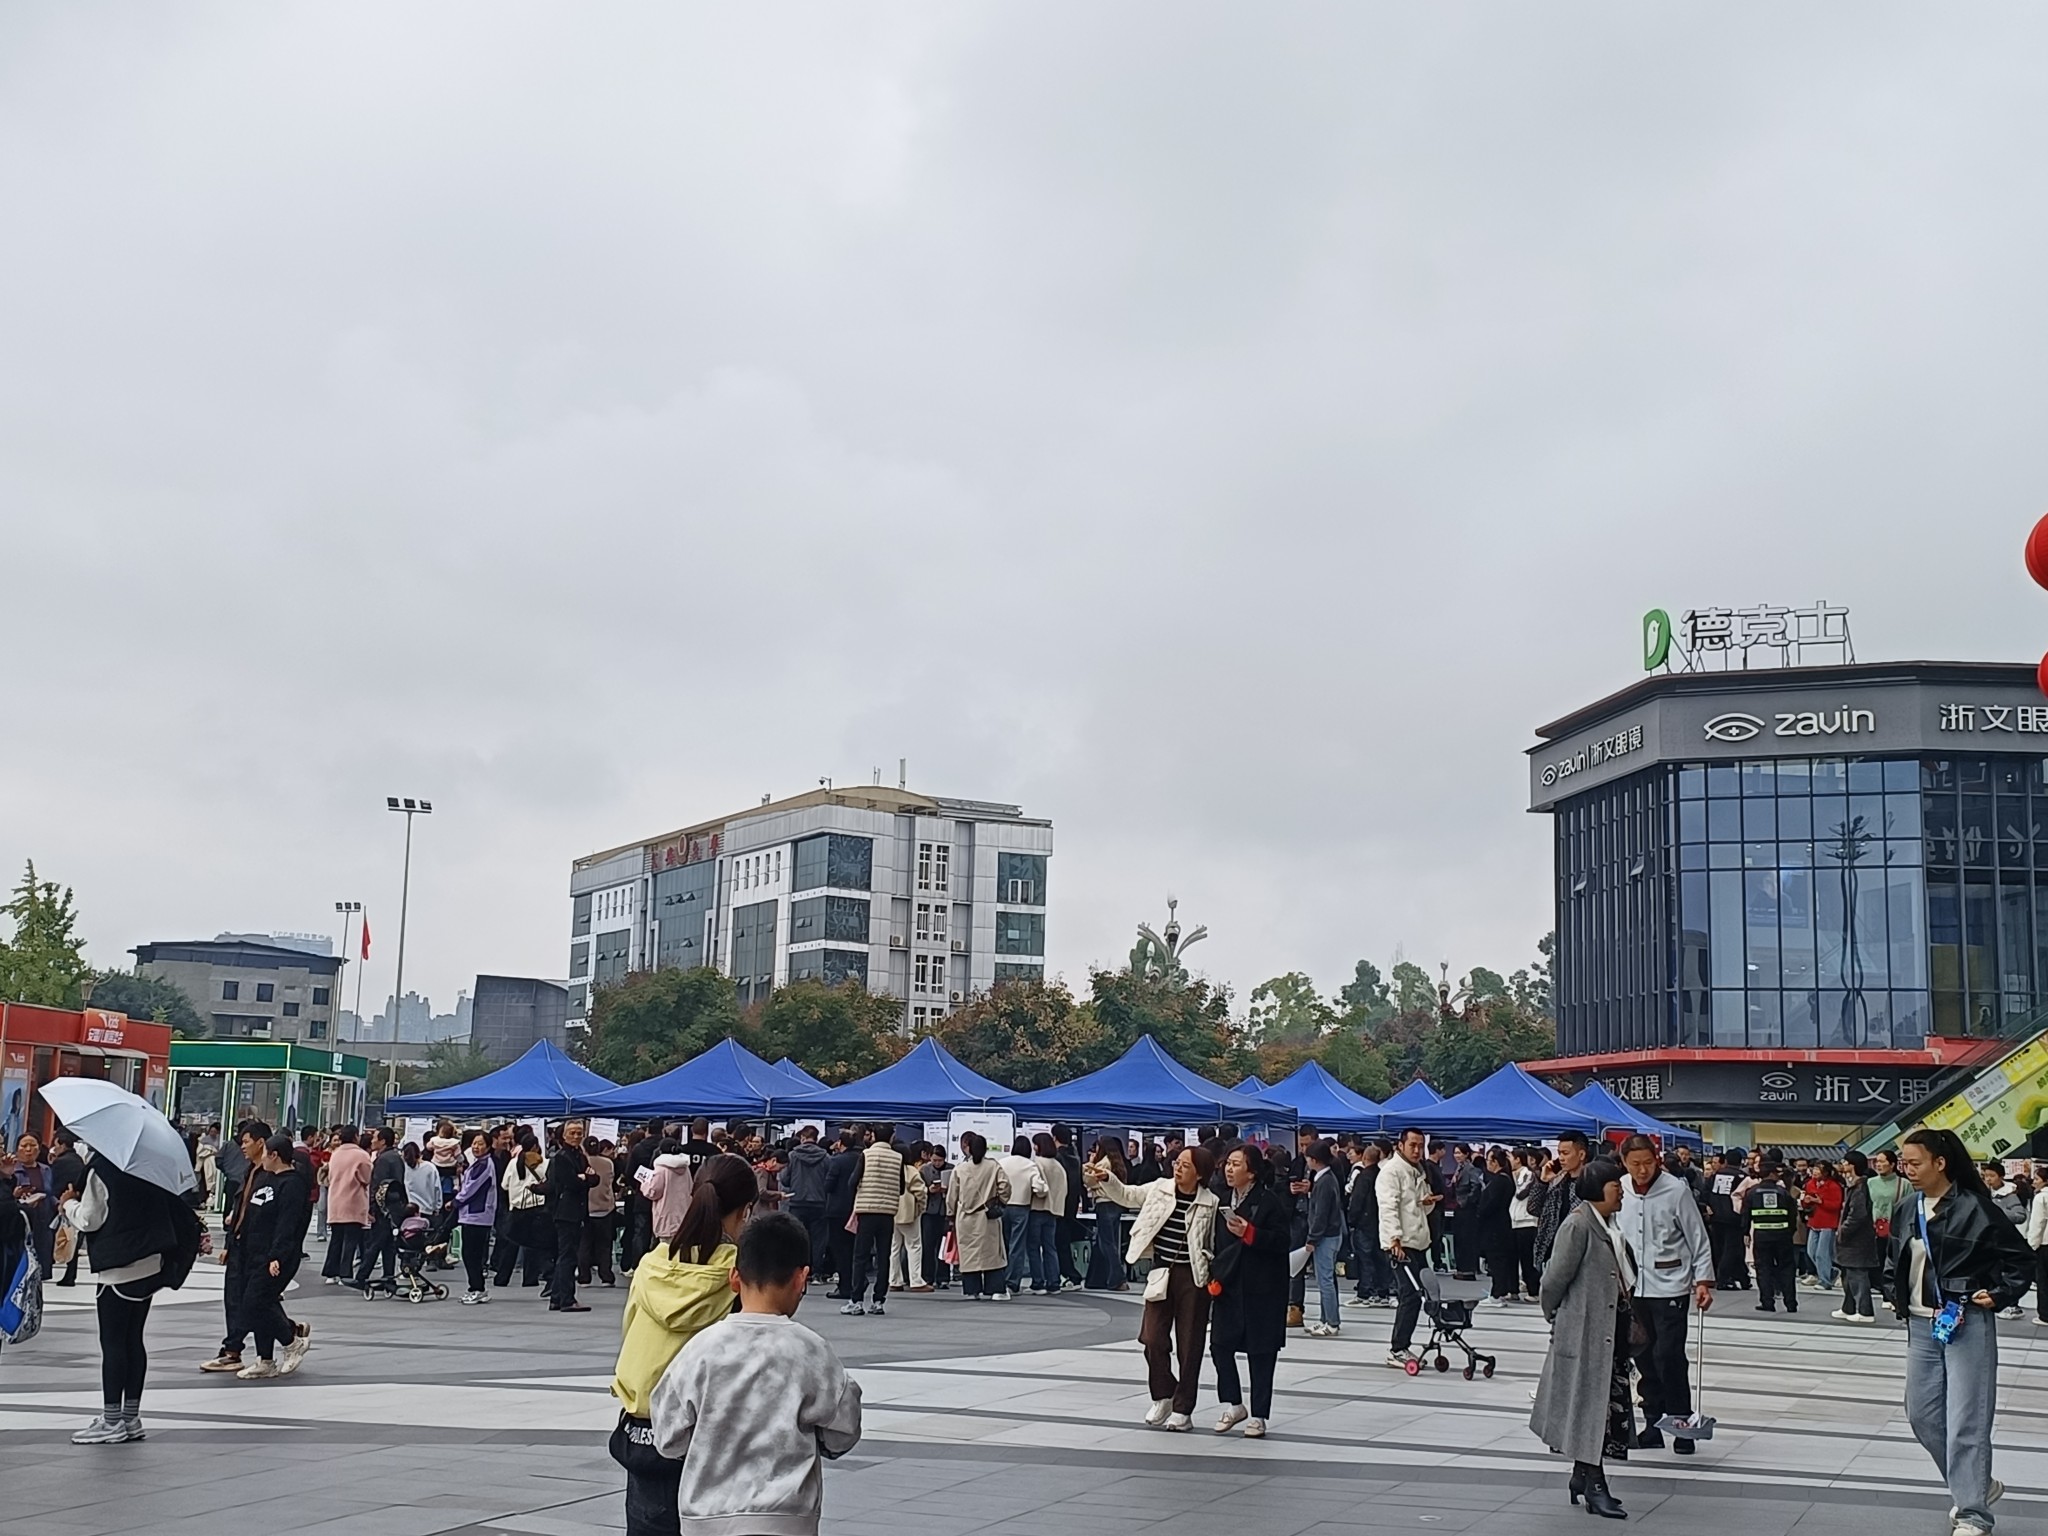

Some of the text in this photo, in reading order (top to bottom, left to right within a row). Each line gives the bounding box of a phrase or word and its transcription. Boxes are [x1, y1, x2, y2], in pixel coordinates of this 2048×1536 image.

[1680, 600, 1849, 652] 德克士
[1775, 704, 1875, 736] zavin
[1939, 703, 2048, 733] 浙文眼
[1558, 724, 1642, 778] zavin 浙文眼镜
[1602, 1074, 1660, 1100] 浙文眼镜
[1760, 1090, 1798, 1101] zavin
[1815, 1075, 1938, 1104] 浙文眼
